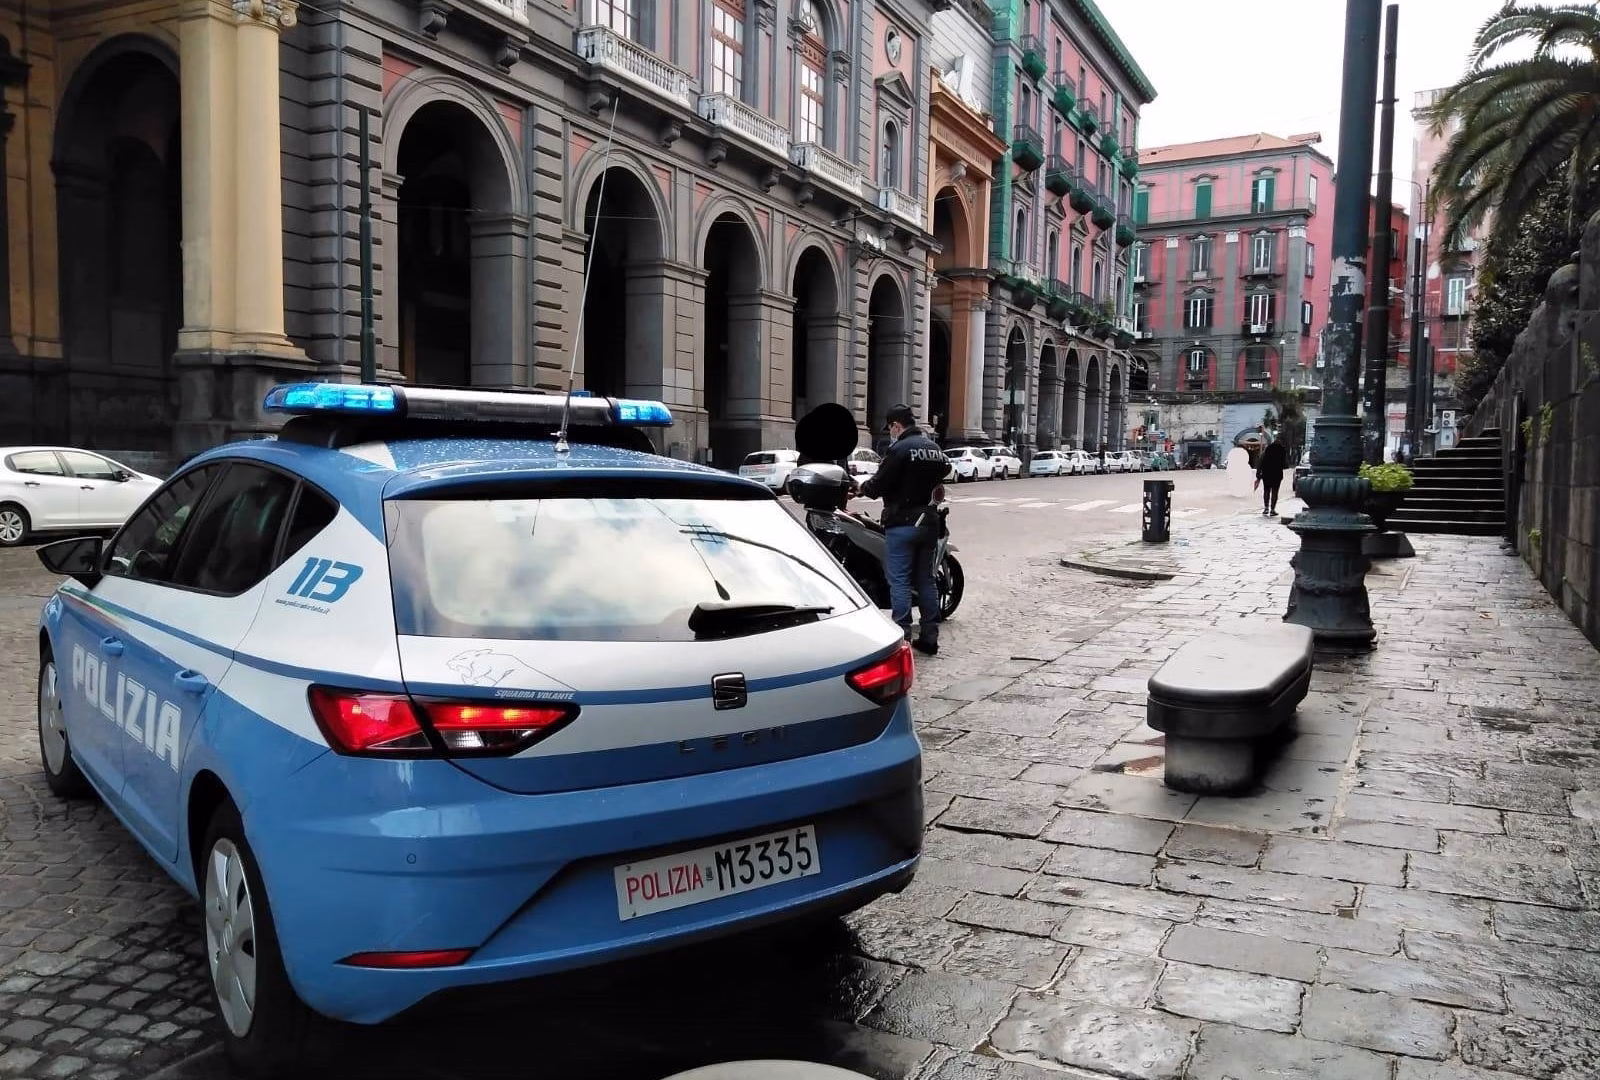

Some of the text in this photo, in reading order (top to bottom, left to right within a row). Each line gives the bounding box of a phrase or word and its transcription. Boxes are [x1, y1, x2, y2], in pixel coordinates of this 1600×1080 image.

[286, 556, 364, 604] 113
[72, 642, 182, 774] POLIZIA
[625, 832, 812, 905] POLIZIA M3335
